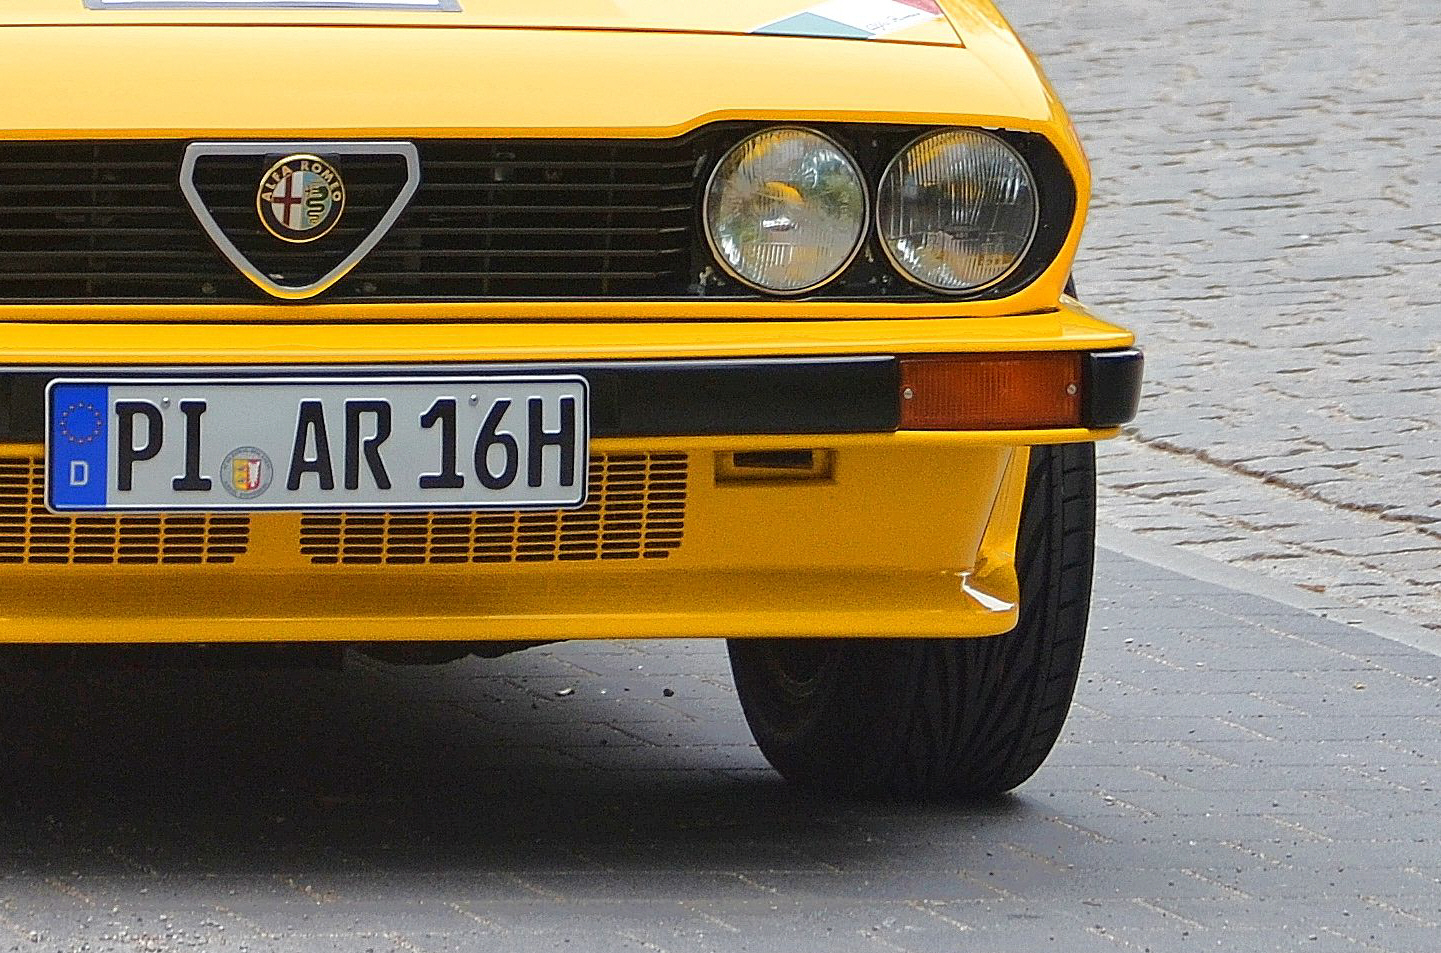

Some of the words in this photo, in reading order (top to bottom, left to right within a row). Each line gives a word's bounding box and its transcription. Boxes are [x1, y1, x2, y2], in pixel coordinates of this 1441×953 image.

[261, 164, 293, 202] ALFA
[300, 160, 341, 202] ROMEO
[114, 399, 212, 493] PI
[286, 399, 392, 492] AR
[418, 397, 577, 491] 16H
[69, 460, 89, 486] D
